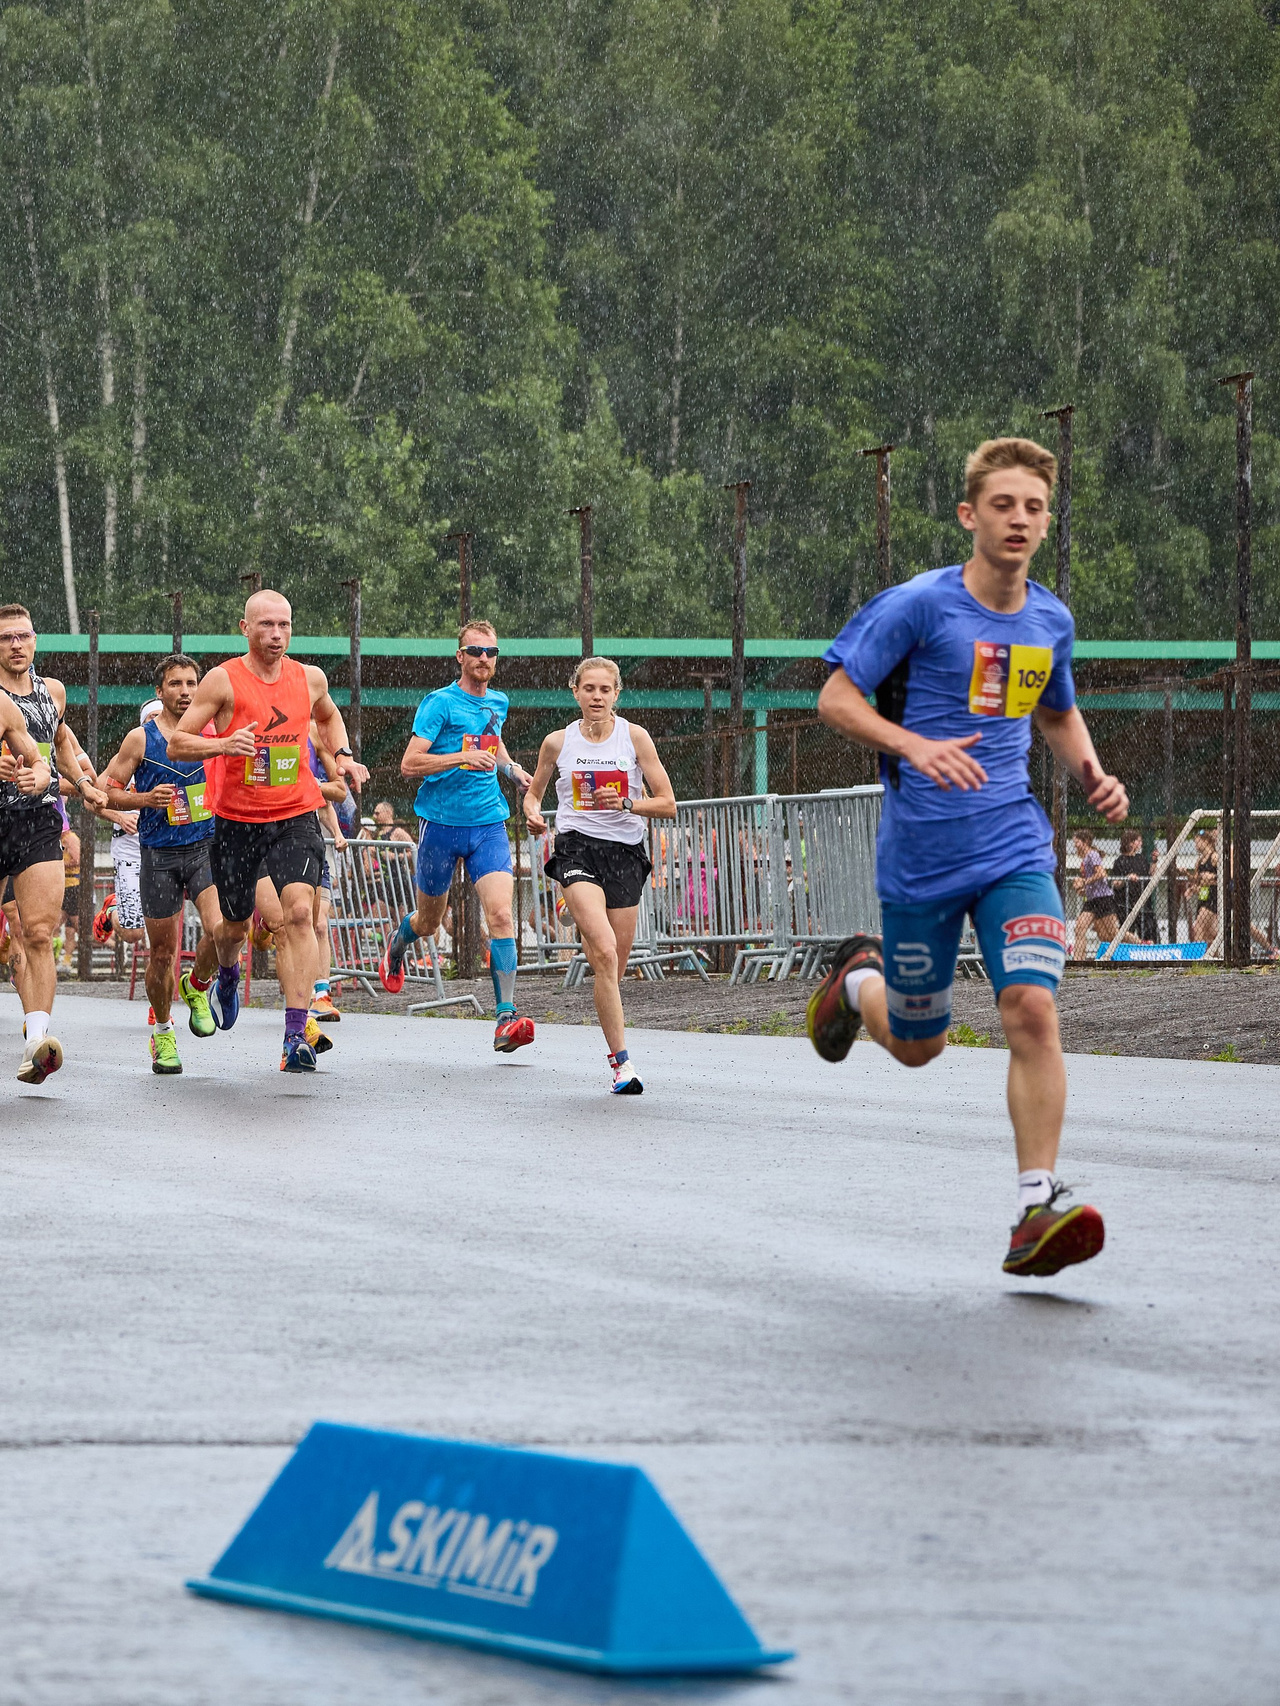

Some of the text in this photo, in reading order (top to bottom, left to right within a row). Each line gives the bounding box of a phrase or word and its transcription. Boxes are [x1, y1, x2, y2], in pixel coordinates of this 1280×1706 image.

[1018, 669, 1046, 688] 109
[254, 734, 300, 744] DEMIX
[276, 758, 297, 770] 187
